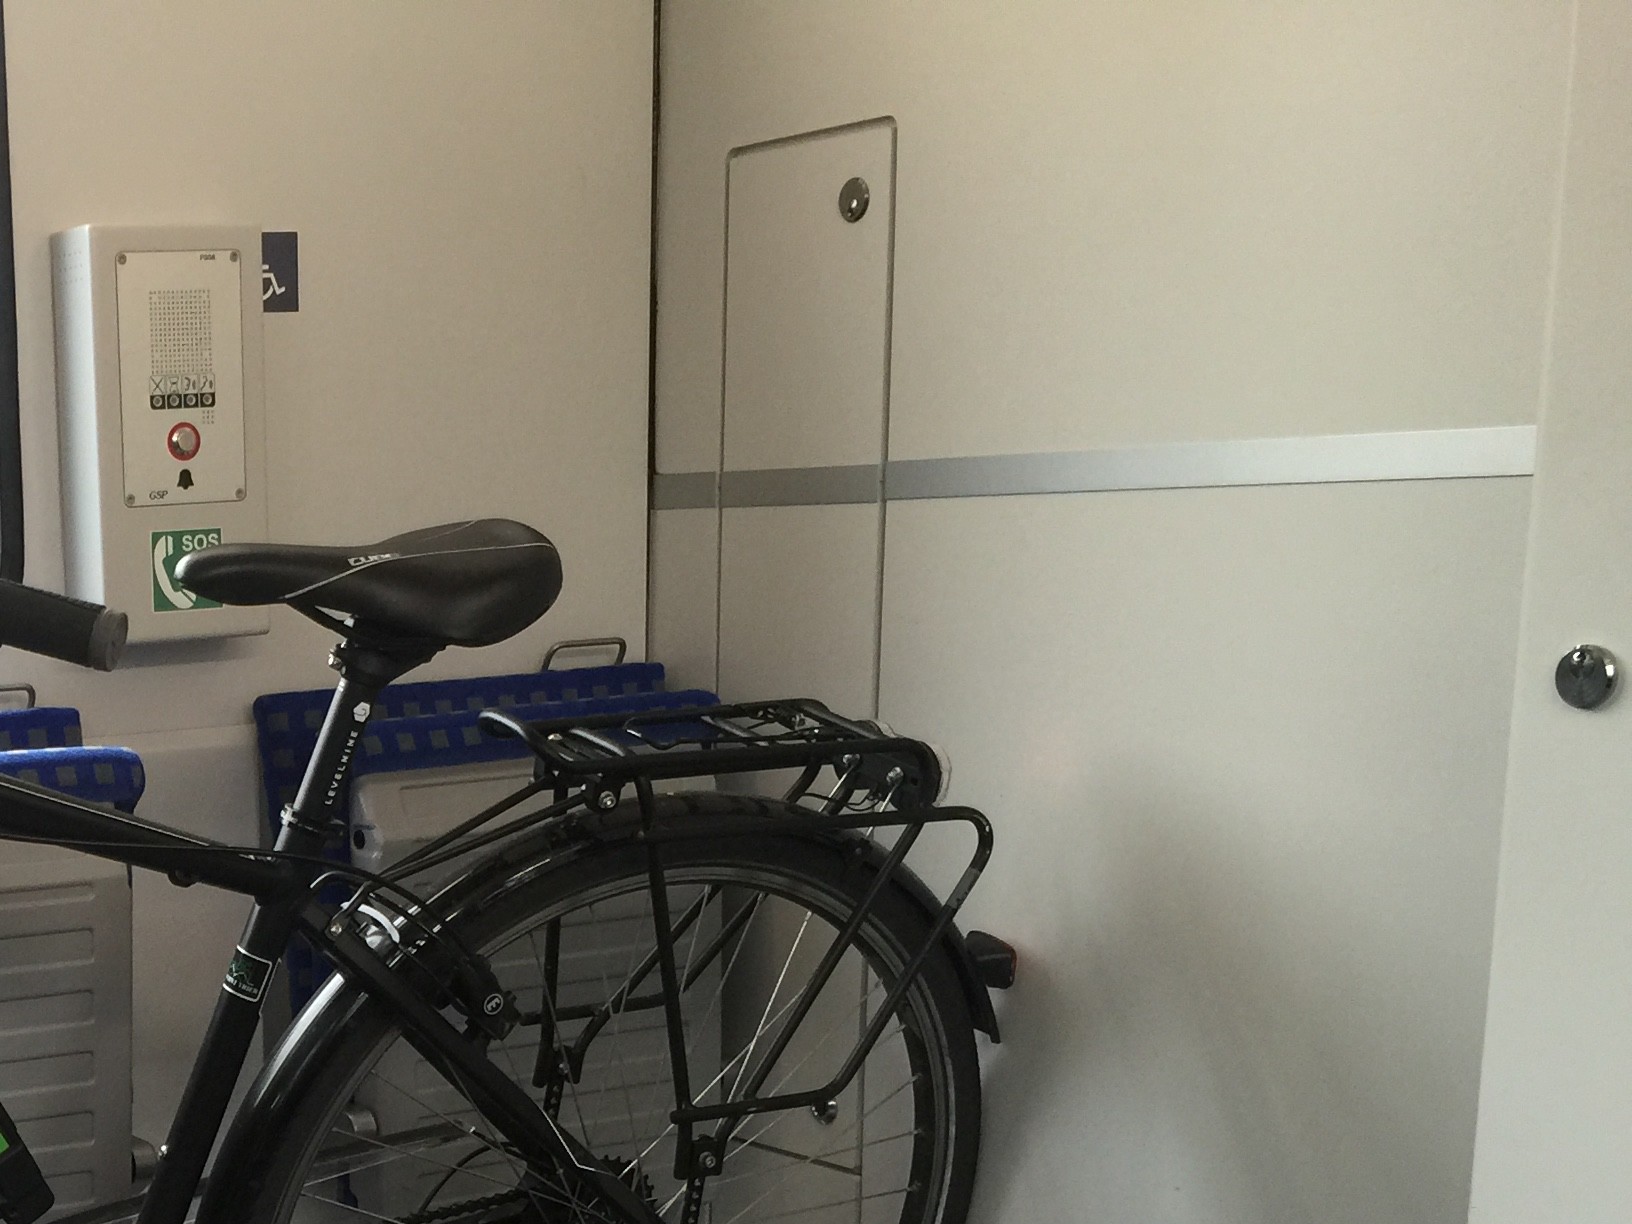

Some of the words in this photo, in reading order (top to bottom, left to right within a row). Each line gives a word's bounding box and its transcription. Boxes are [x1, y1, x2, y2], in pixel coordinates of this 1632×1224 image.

[149, 490, 168, 500] GSP
[181, 533, 219, 552] SOS
[324, 730, 359, 806] LEVELNINE
